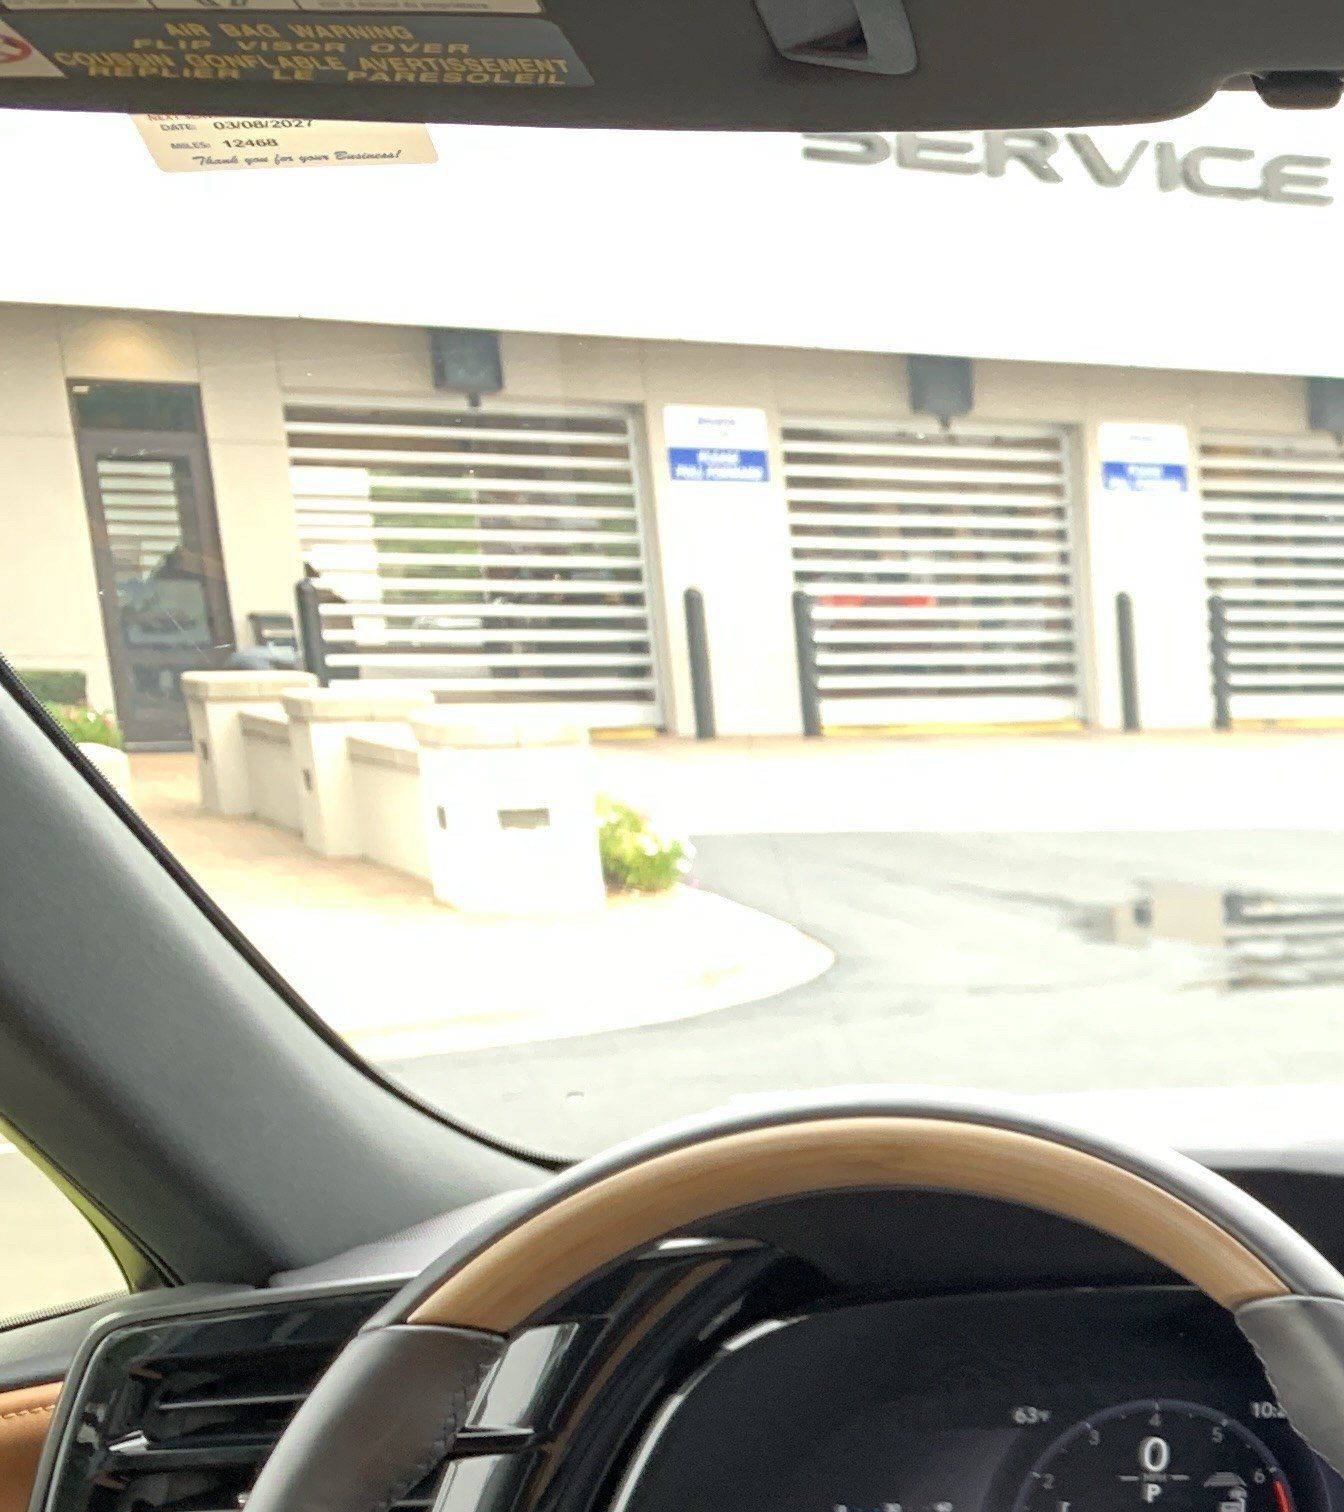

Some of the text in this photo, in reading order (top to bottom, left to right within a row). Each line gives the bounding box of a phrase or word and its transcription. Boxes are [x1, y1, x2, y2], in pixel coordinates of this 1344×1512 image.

[164, 22, 414, 40] AIR BAG WARNING
[133, 38, 471, 54] FLIP VISOR OVER
[54, 52, 568, 74] COUSSIN GONFLABLE AVERTISSEMENT
[87, 65, 566, 85] REPLIER LE PARESOLEIL
[213, 120, 314, 130] 03/08/2027
[223, 139, 279, 149] 12468
[192, 150, 402, 166] Thank you for your Business!
[803, 130, 1334, 206] SERVICE
[1252, 1402, 1287, 1418] 10:2
[1149, 1412, 1161, 1426] 4
[1088, 1428, 1100, 1446] 3
[1212, 1425, 1223, 1442] 5
[1143, 1436, 1170, 1472] 0
[1042, 1472, 1055, 1490] 2
[1254, 1469, 1265, 1484] 6
[1147, 1484, 1162, 1502] P
